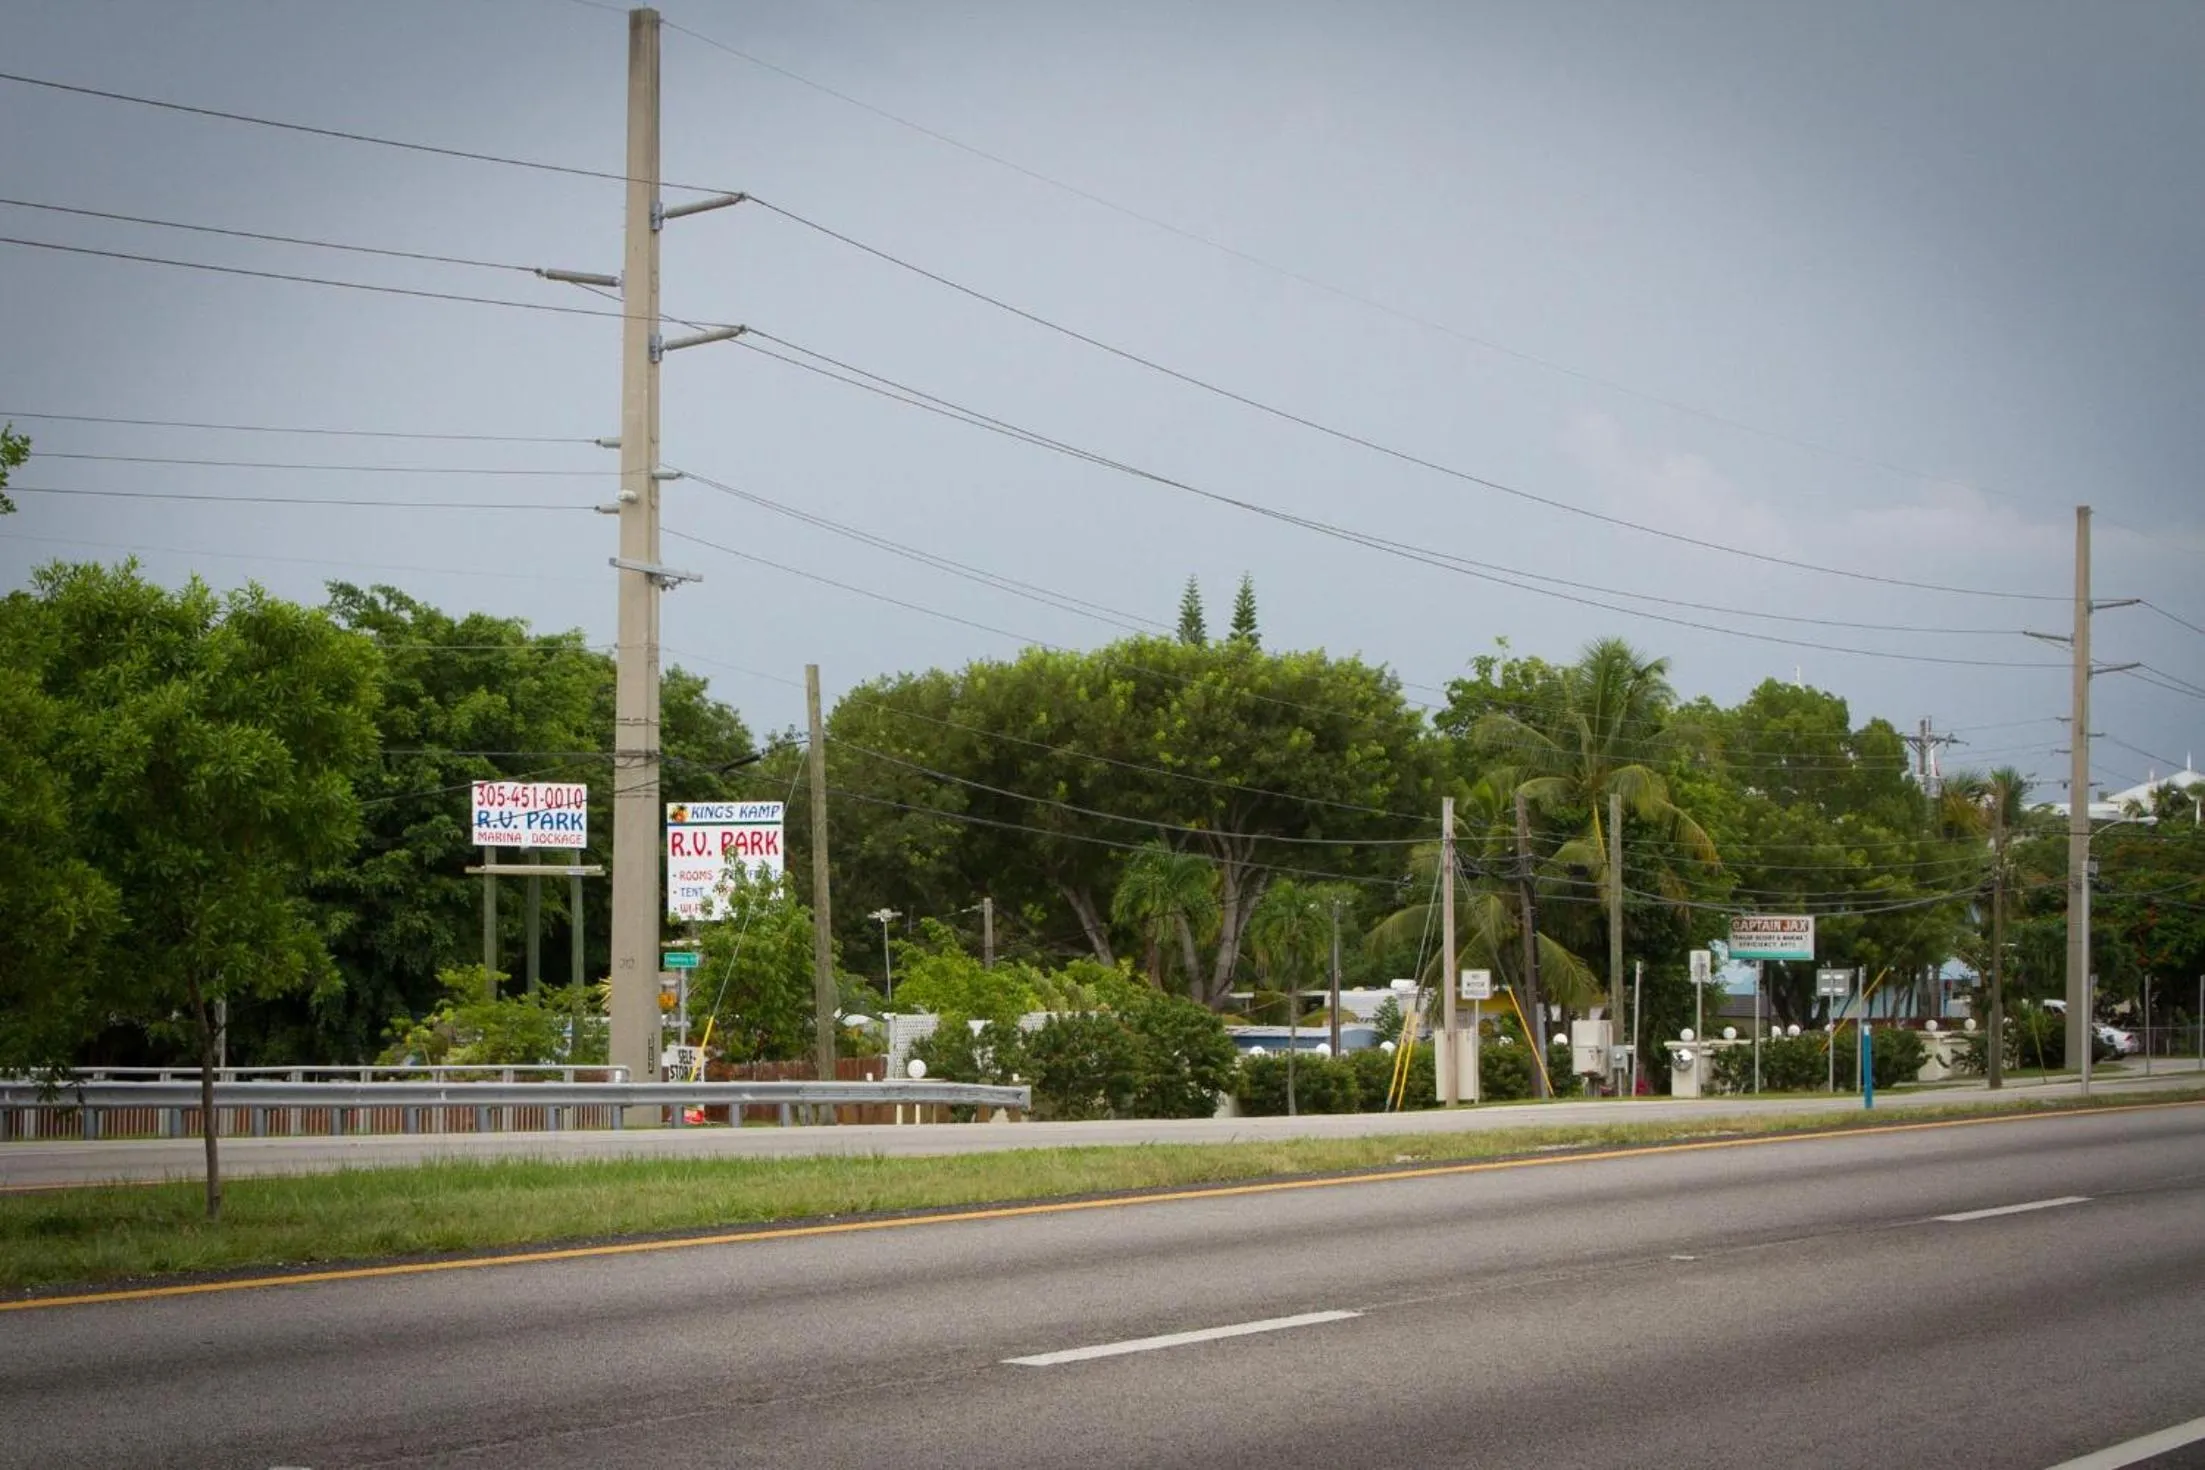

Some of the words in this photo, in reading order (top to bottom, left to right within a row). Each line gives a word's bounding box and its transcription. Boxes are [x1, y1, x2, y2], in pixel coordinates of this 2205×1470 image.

[477, 784, 583, 809] 305-451-0010
[691, 805, 734, 819] KINGS
[739, 804, 780, 818] KAMP
[477, 810, 518, 829] R.V.
[526, 811, 584, 831] PARK
[477, 832, 522, 843] MARINA
[531, 833, 583, 844] DOCKAGE
[671, 831, 713, 857] R.V.
[721, 830, 778, 856] PARK
[680, 870, 714, 881] ROOMS
[680, 887, 704, 898] TENT
[680, 903, 704, 914] WI-F
[1732, 919, 1780, 932] CAPTAIN
[1783, 919, 1808, 932] JAX
